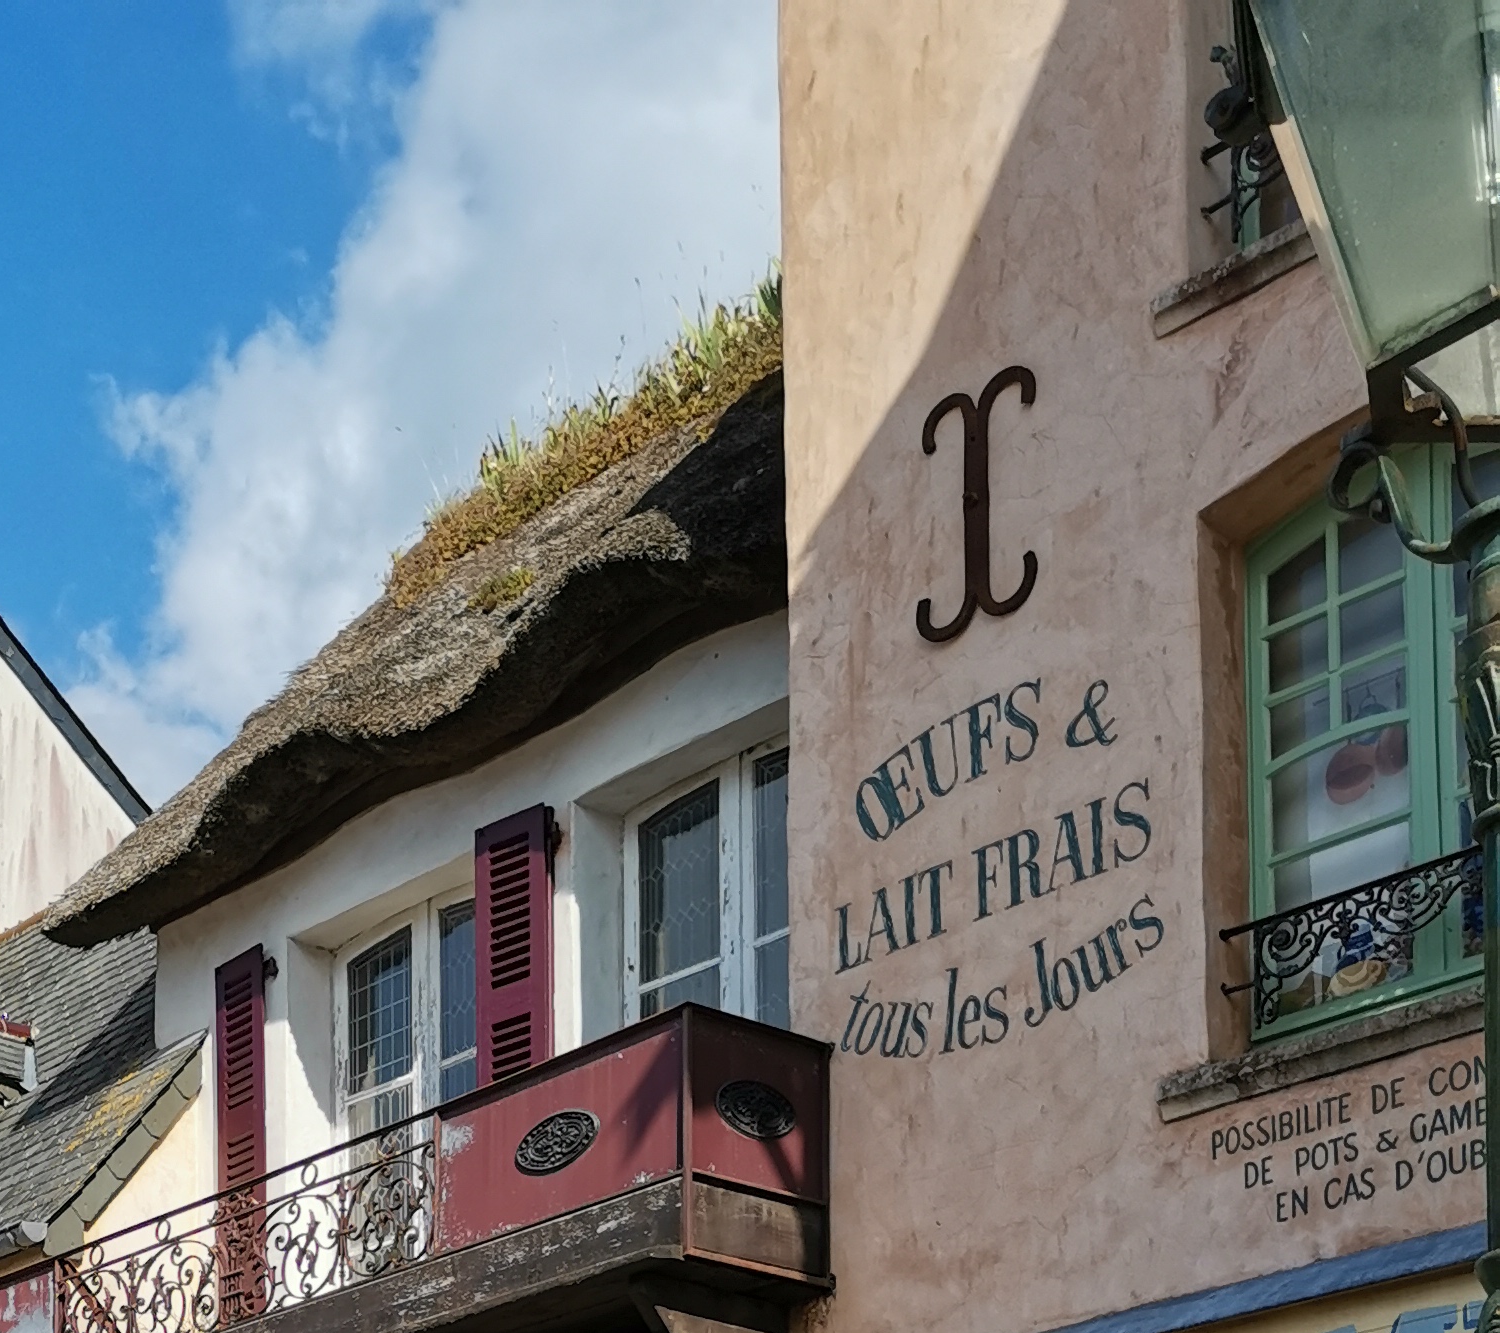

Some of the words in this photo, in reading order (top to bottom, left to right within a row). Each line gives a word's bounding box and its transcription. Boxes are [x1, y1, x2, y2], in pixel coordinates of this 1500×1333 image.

[856, 677, 1041, 842] ŒUFS
[1065, 679, 1118, 748] &
[835, 860, 953, 975] LAIT
[971, 777, 1152, 922] FRAIS
[840, 979, 933, 1059] tous
[939, 967, 1010, 1056] les
[1024, 893, 1164, 1028] Jours
[1212, 1092, 1352, 1160] POSSIBILITE
[1371, 1077, 1405, 1115] DE
[1429, 1055, 1486, 1096] CON
[1244, 1156, 1273, 1189] DE
[1295, 1132, 1359, 1176] POTS
[1376, 1129, 1398, 1153] &
[1409, 1096, 1486, 1143] GAME
[1277, 1186, 1308, 1223] EN
[1324, 1167, 1375, 1209] CAS
[1395, 1139, 1487, 1191] D'OUB
